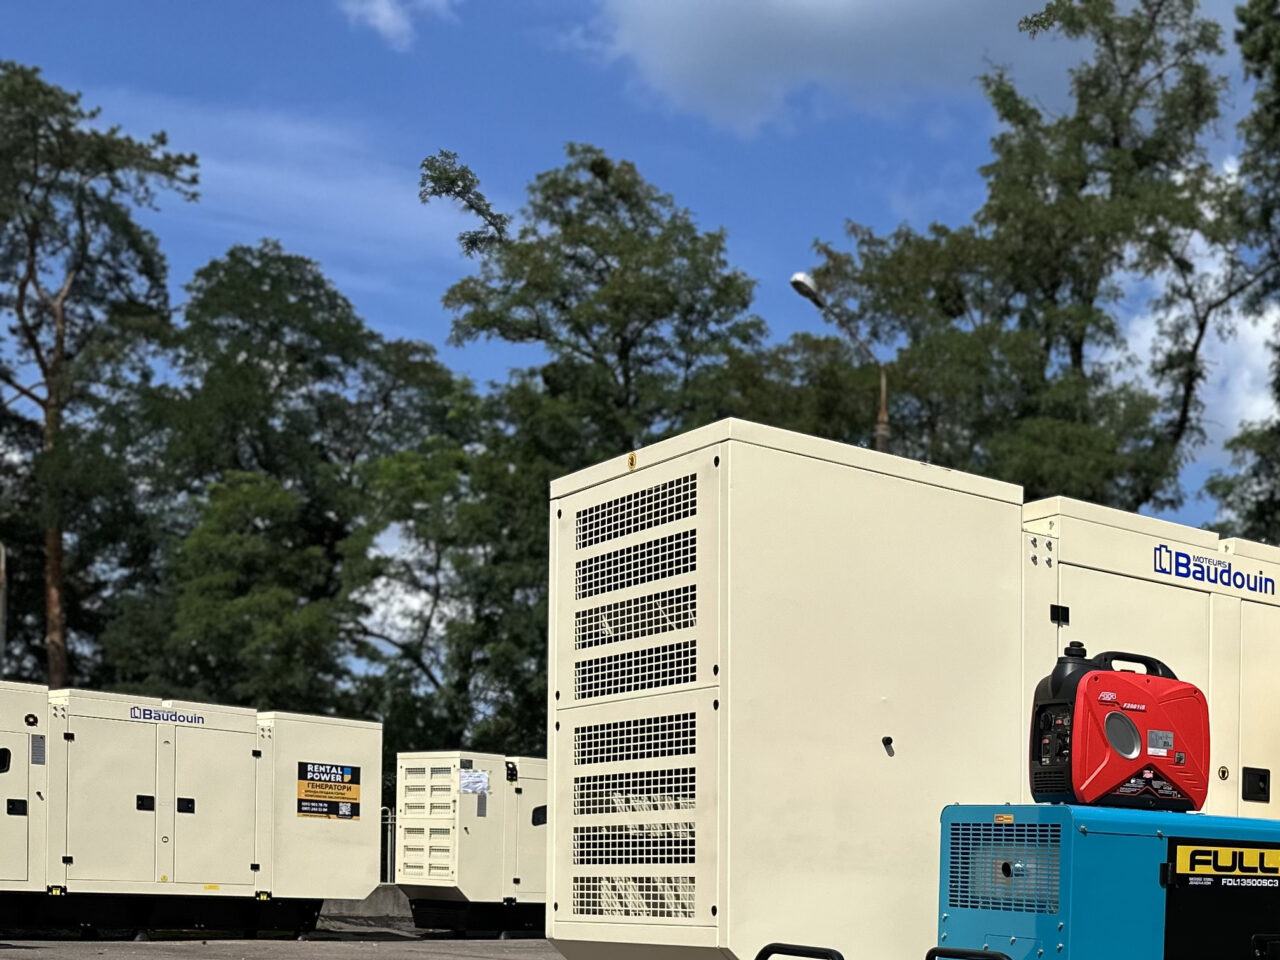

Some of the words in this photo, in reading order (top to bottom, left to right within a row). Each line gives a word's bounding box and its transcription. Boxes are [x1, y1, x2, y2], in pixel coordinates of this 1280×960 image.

[1192, 555, 1227, 568] MOTEURS
[1175, 551, 1275, 595] Baudouin
[143, 709, 204, 724] Baudouin
[307, 764, 342, 775] RENTAL
[307, 772, 342, 782] POWER
[307, 782, 352, 792] ГЕНЕРАТОРИ
[1189, 849, 1279, 874] FULL
[1221, 878, 1279, 887] FDL13500SC3
